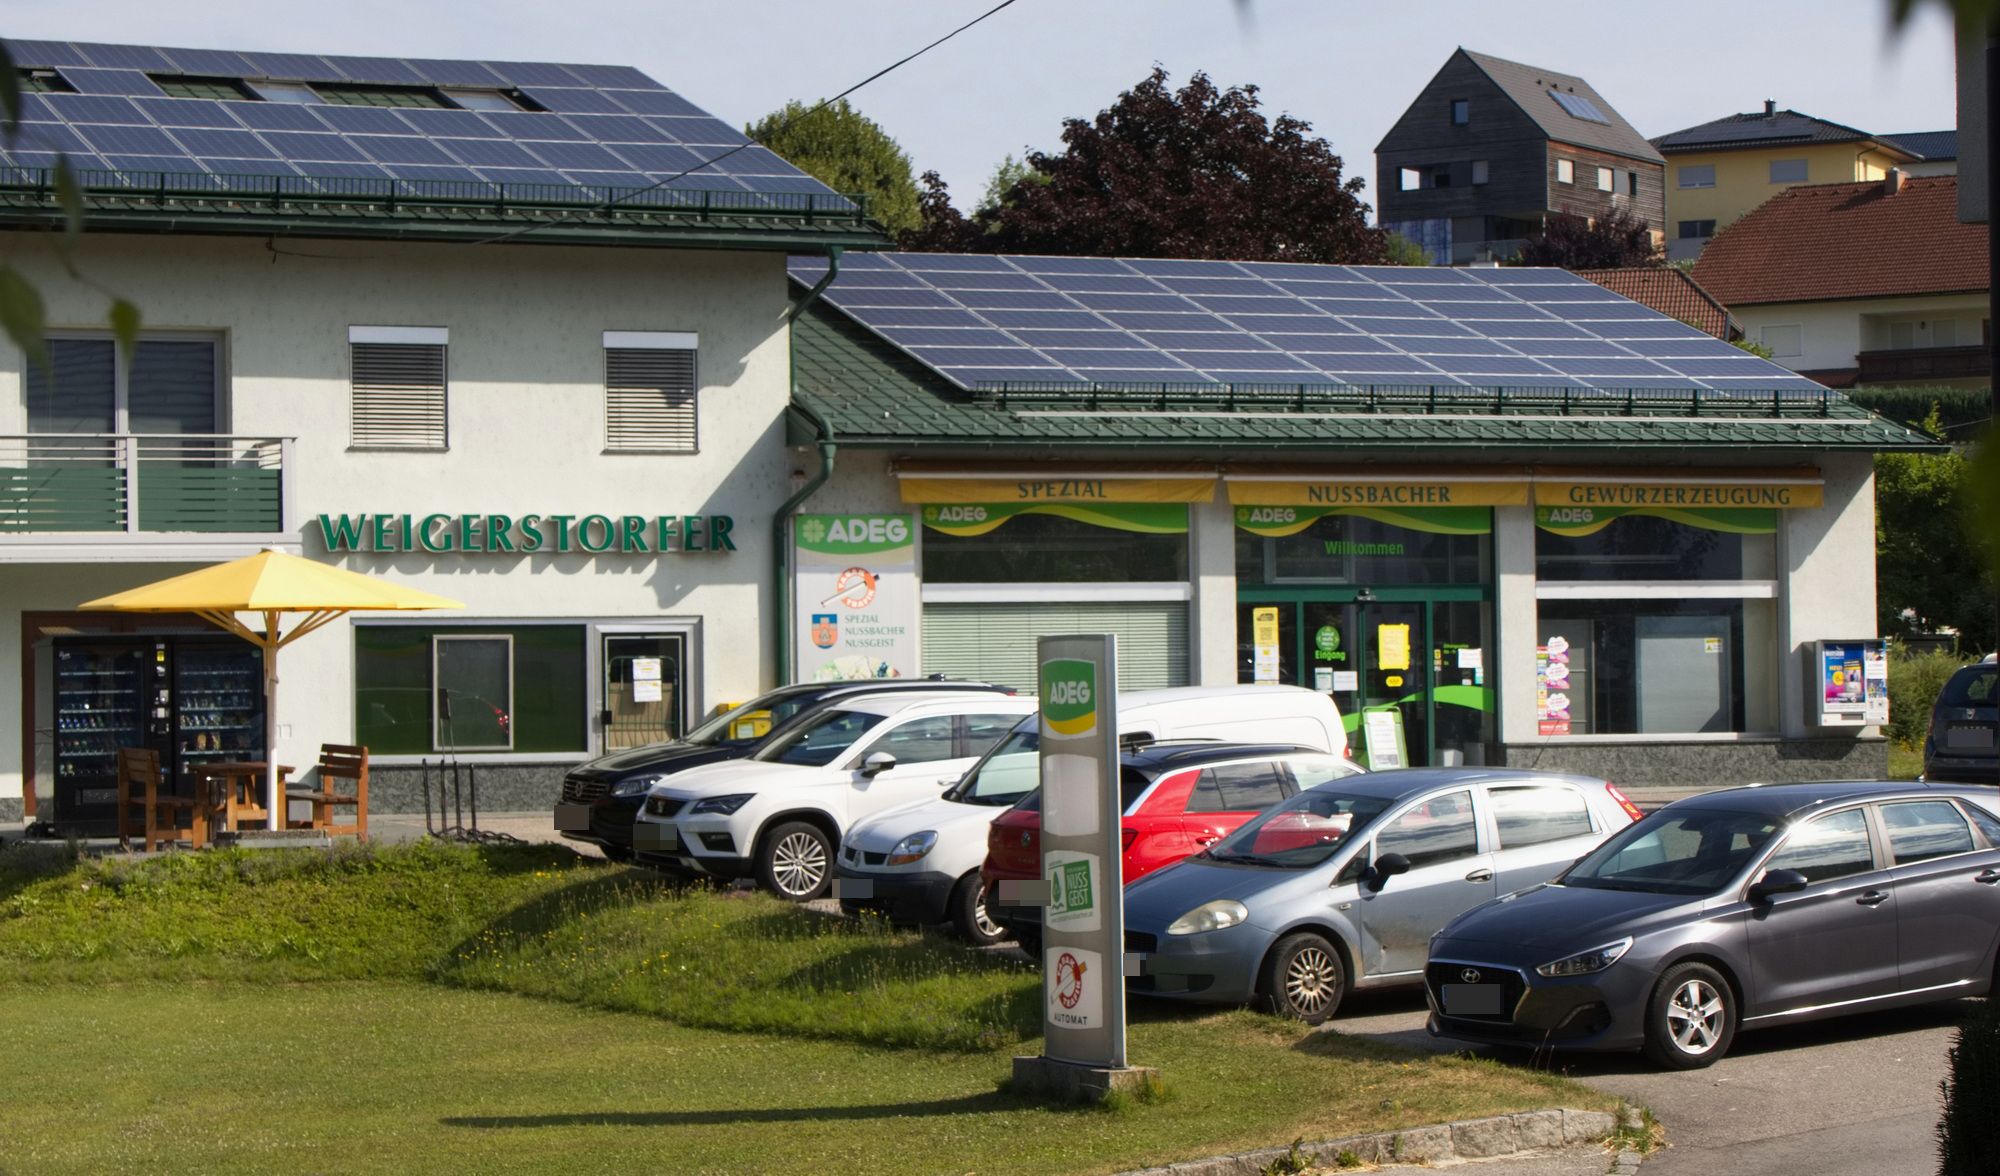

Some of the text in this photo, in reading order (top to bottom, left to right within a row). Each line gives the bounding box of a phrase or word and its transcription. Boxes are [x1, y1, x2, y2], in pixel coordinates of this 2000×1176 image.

[1018, 480, 1107, 498] SPEZIAL
[1308, 486, 1451, 502] NUSSBACHER
[1569, 484, 1791, 505] GEWÜRZERZEUGUNG
[939, 507, 987, 521] ADEG
[1250, 508, 1296, 523] ADEG
[1550, 508, 1594, 523] ADEG
[319, 513, 737, 553] WEIGERSTORFER
[827, 519, 908, 543] ADEG
[1324, 540, 1404, 555] Willkommen
[844, 615, 879, 624] SPEZIAL
[844, 626, 905, 636] NUSSBACHER
[845, 638, 895, 648] NUSSGEIST
[1049, 681, 1091, 704] ADEG
[1066, 871, 1088, 890] NUSS
[1068, 888, 1088, 907] GEIST
[1054, 1012, 1088, 1025] AUTOMAT
